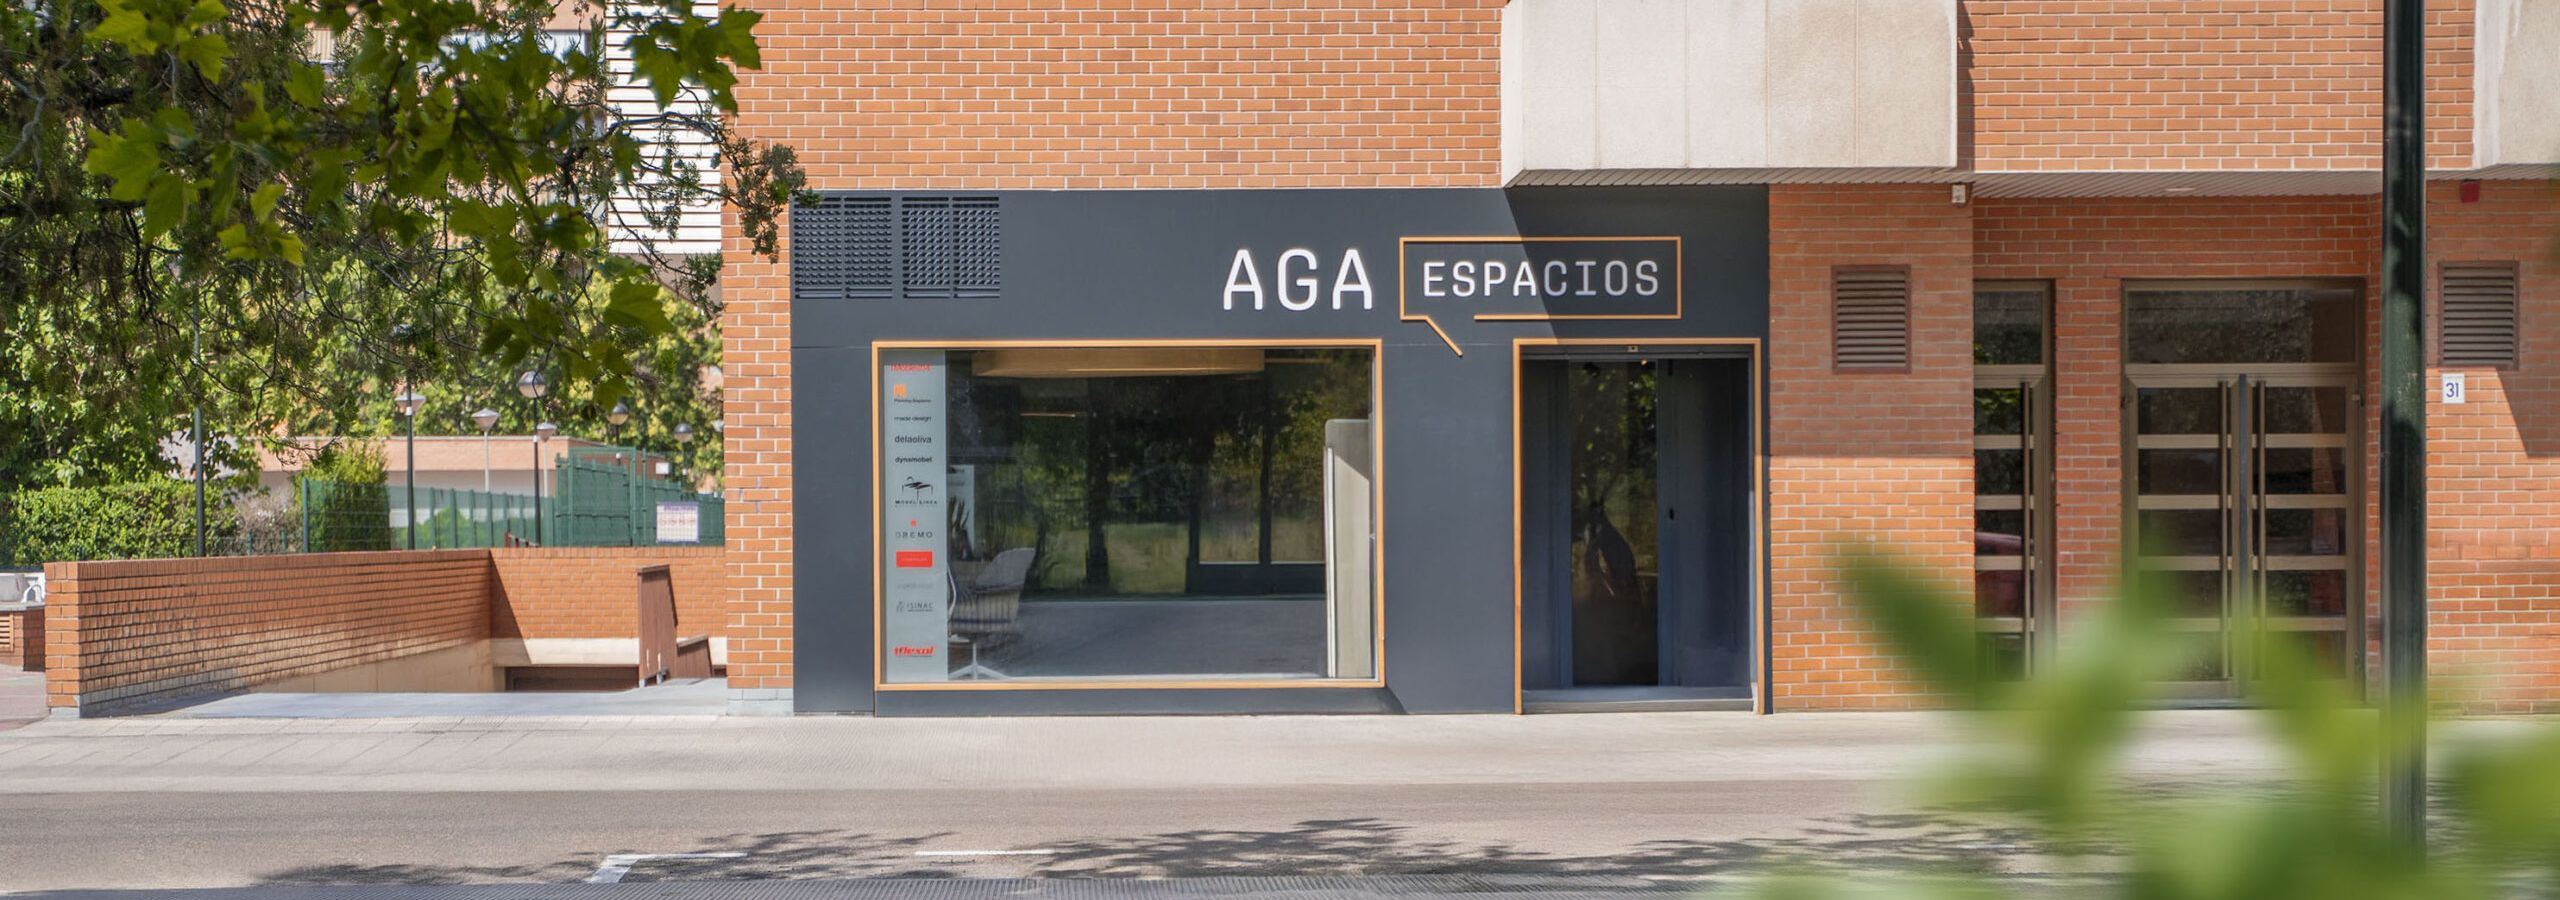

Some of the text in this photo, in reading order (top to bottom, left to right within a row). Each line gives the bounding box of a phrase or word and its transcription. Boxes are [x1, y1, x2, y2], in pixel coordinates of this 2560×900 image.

[1222, 248, 1660, 311] AGA ESPACIOS
[2446, 382, 2459, 398] 31
[894, 435, 932, 443] delaoliva
[894, 456, 932, 464] dynamobel
